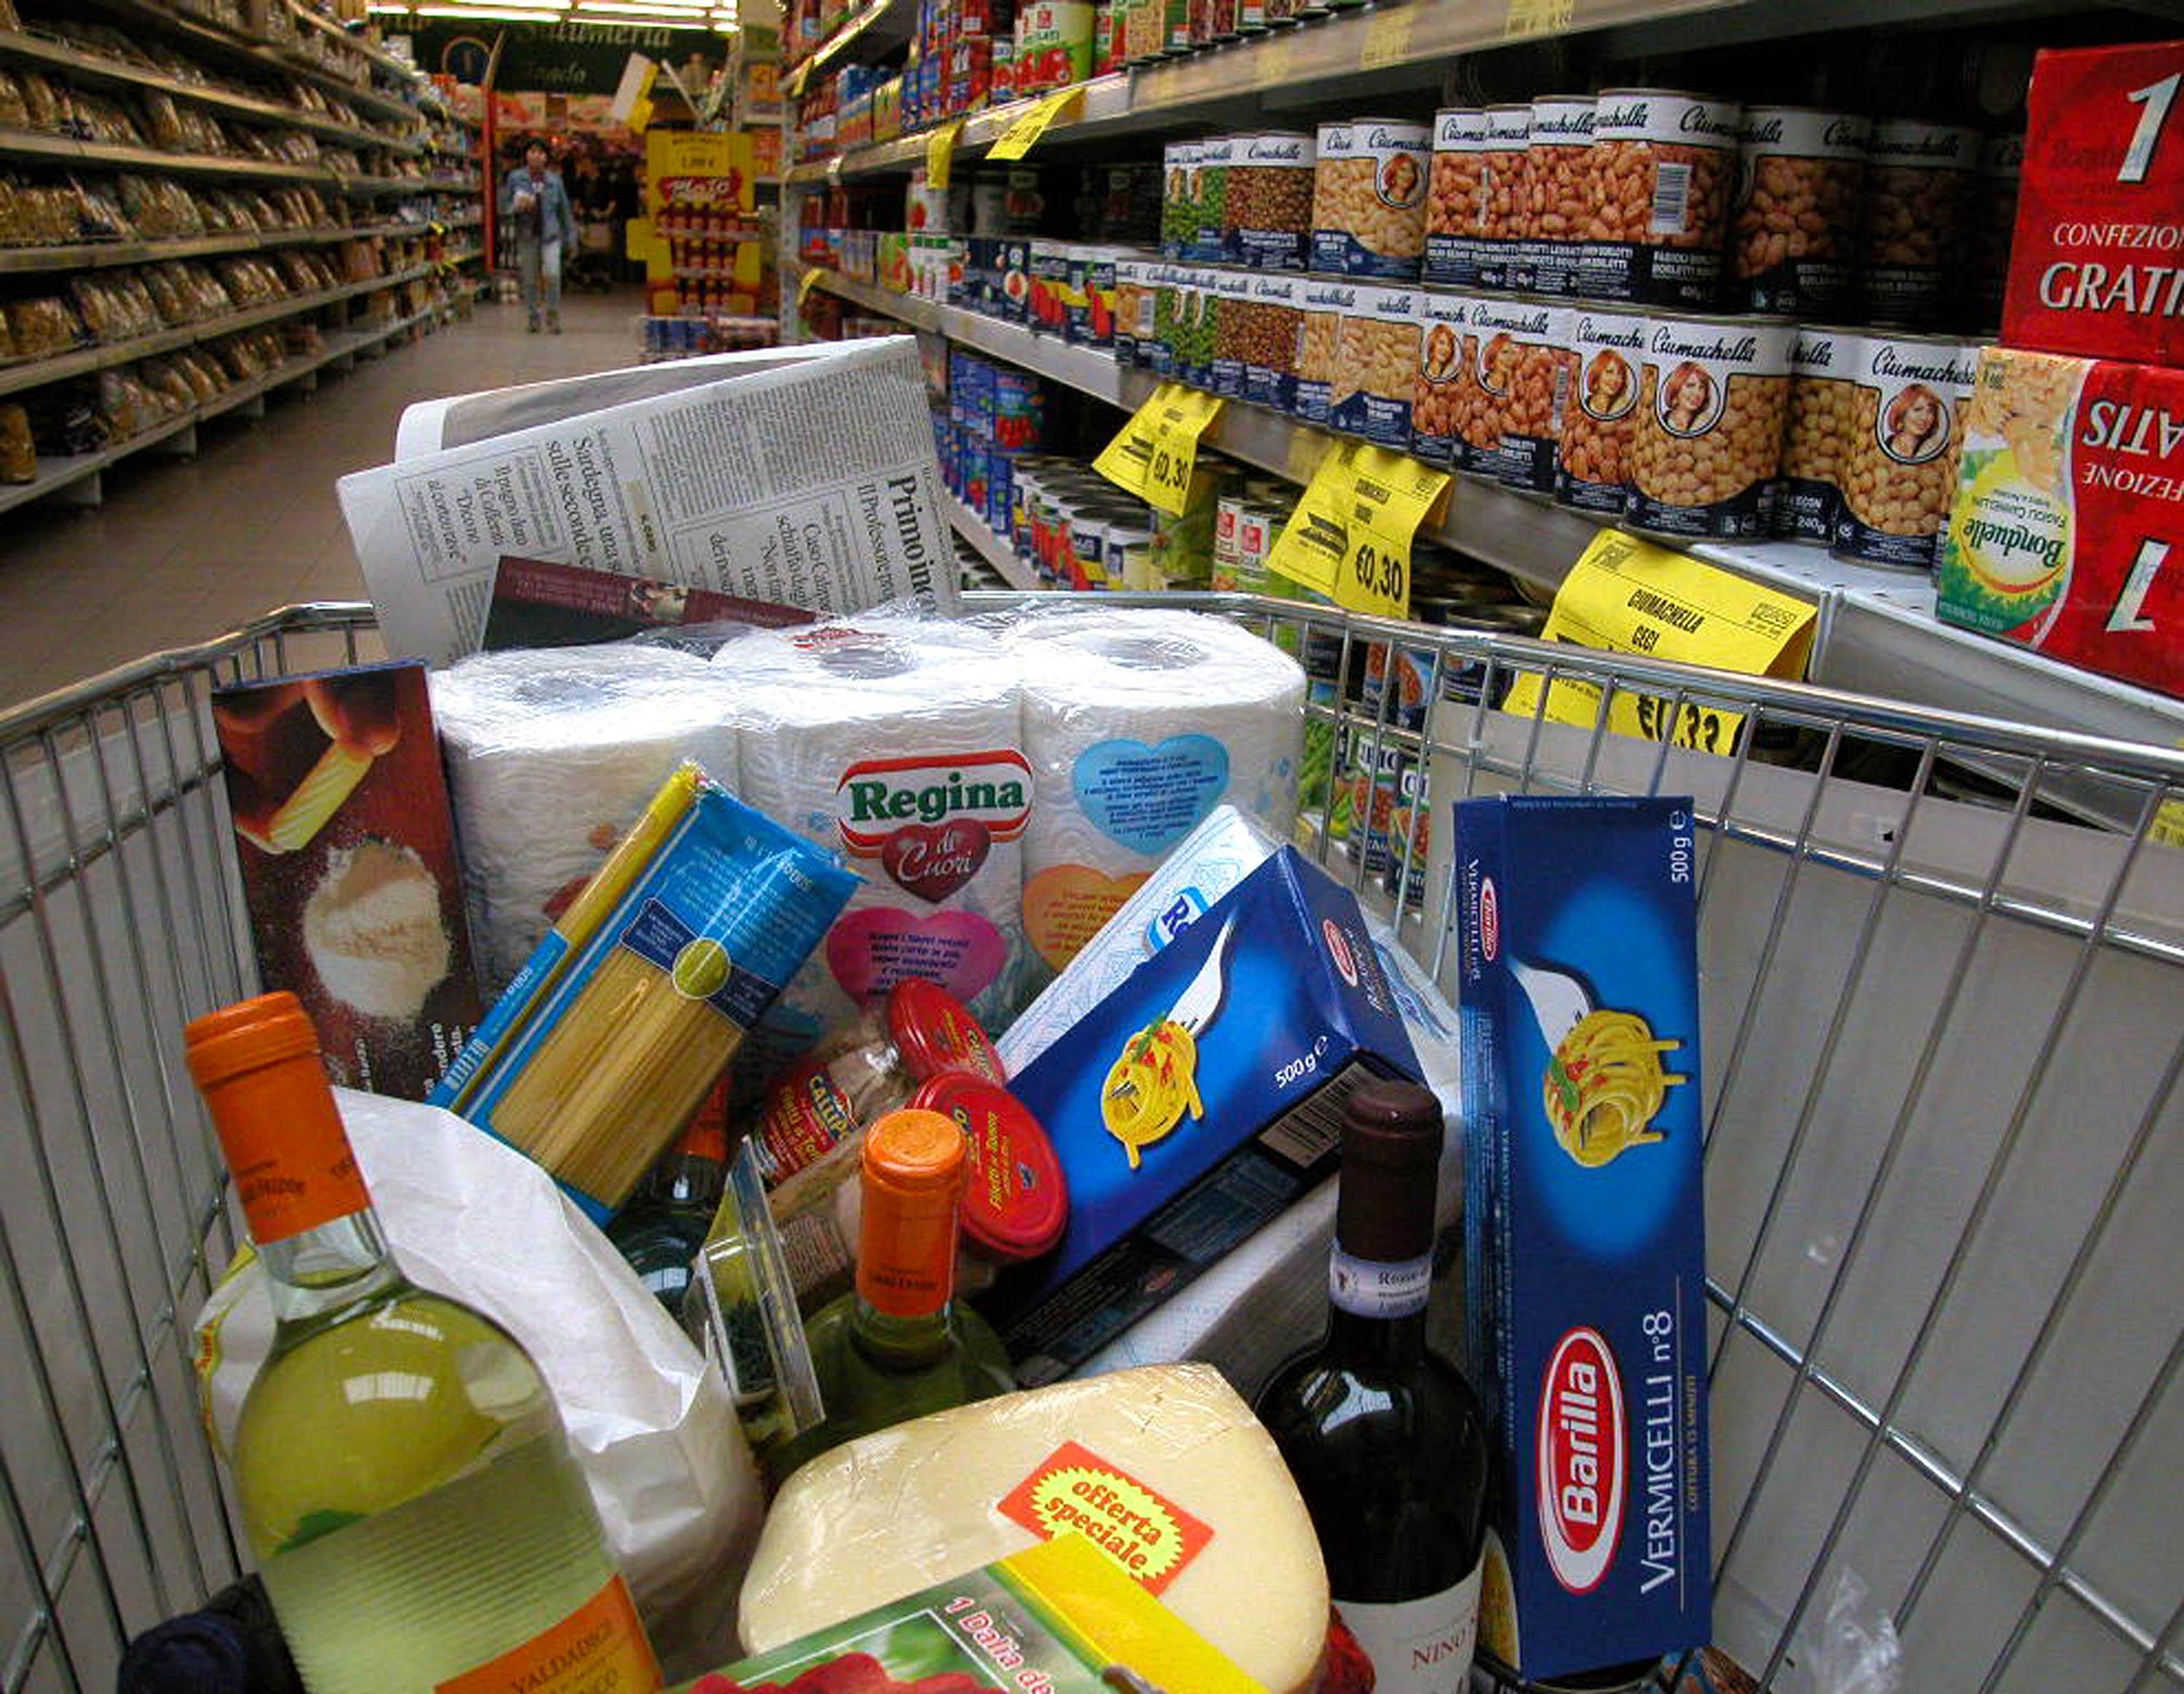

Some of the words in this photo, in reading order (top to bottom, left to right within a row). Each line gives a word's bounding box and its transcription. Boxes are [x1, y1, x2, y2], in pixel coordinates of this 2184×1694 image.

[2040, 262, 2184, 318] GRATI
[1651, 326, 1757, 363] Ciumachella
[558, 481, 593, 553] seconde
[888, 475, 925, 565] Primo
[1963, 518, 2065, 568] Bonduelle
[1356, 544, 1402, 603] €0,30
[1628, 589, 1705, 634] CIUMACHELLA
[1631, 625, 1660, 650] CECI
[849, 772, 1024, 823] Regina
[898, 842, 971, 882] Cuori
[936, 828, 954, 855] di
[1561, 1361, 1599, 1527] Barilla
[1072, 1479, 1162, 1545] offerta
[1640, 1374, 1675, 1594] VERMICELLI
[1045, 1497, 1149, 1571] speciale
[960, 1611, 1024, 1669] Dalia
